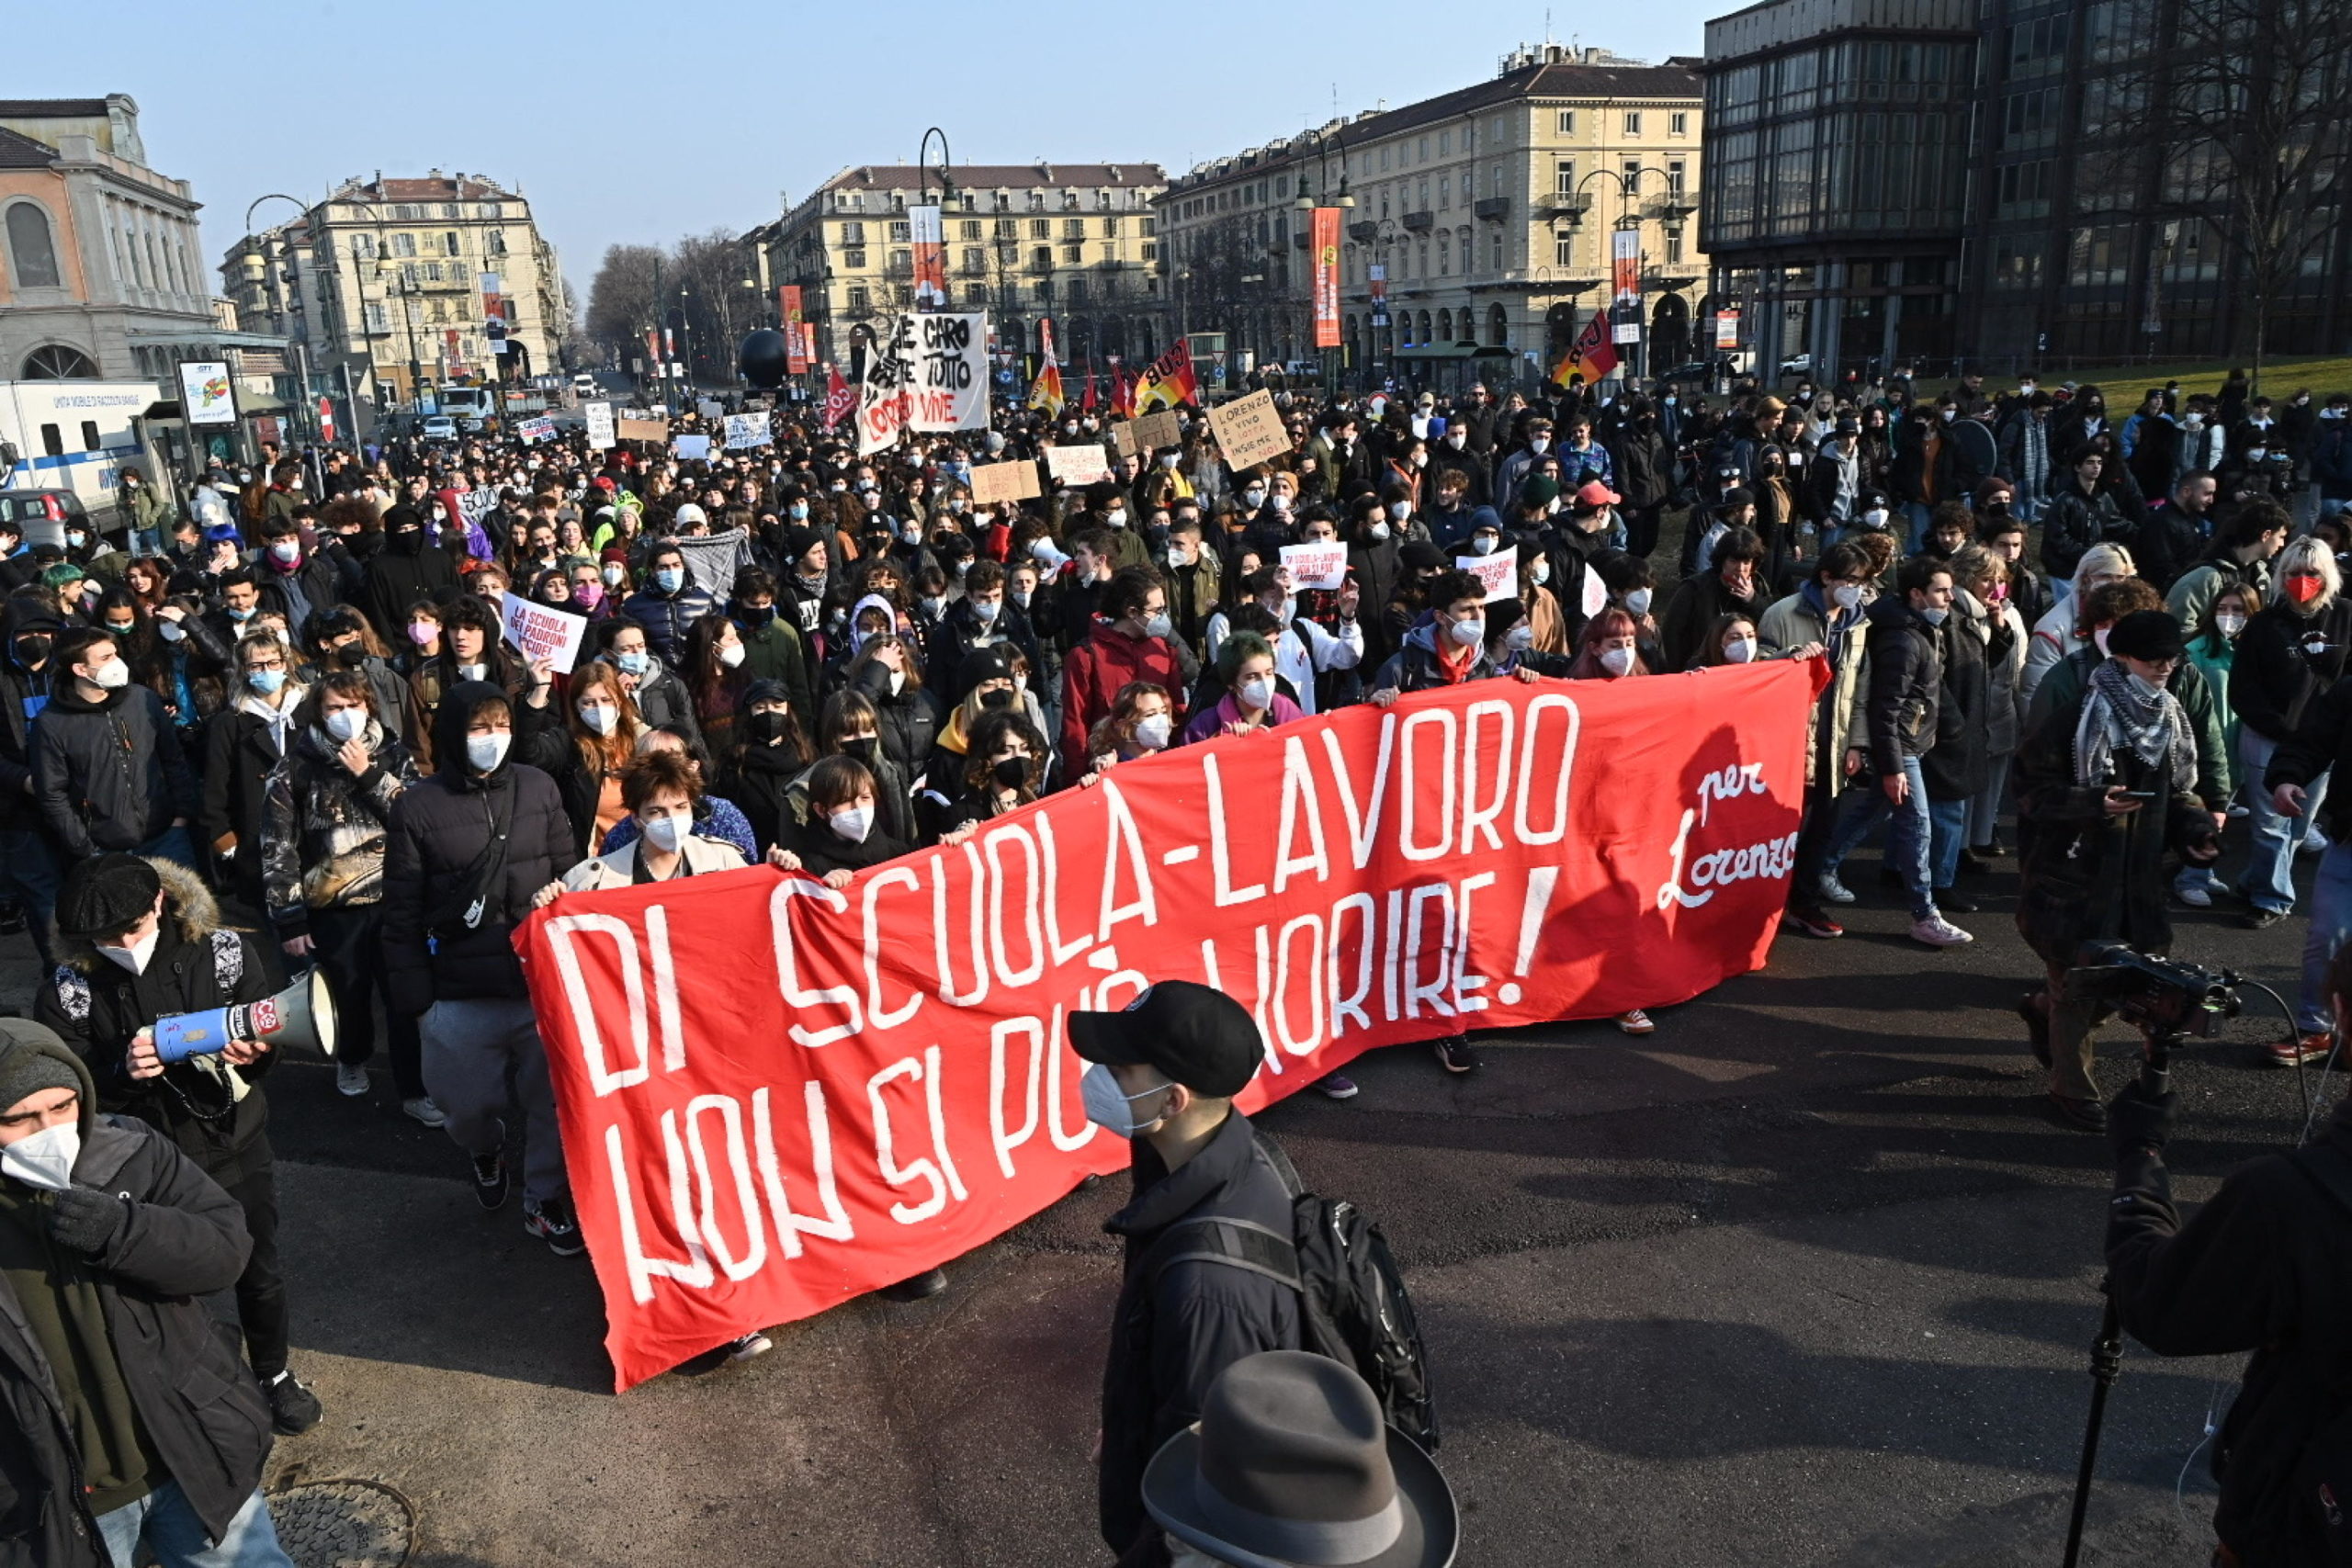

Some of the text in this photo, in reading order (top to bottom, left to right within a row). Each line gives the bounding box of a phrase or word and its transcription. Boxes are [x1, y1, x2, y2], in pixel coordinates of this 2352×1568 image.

[923, 316, 970, 351] CARO
[923, 351, 972, 390] TUTTO
[1218, 395, 1270, 424] LORENZO
[1236, 414, 1260, 429] VIVO
[1231, 434, 1272, 457] INSIEME
[511, 616, 568, 649] DEI PADRONI
[515, 605, 567, 634] LA SCUOLA
[1697, 761, 1767, 828] per
[1657, 807, 1799, 910] Lorenzo
[544, 694, 1580, 1098] DI SCUOLA-LAVORO
[865, 1045, 967, 1225] SI
